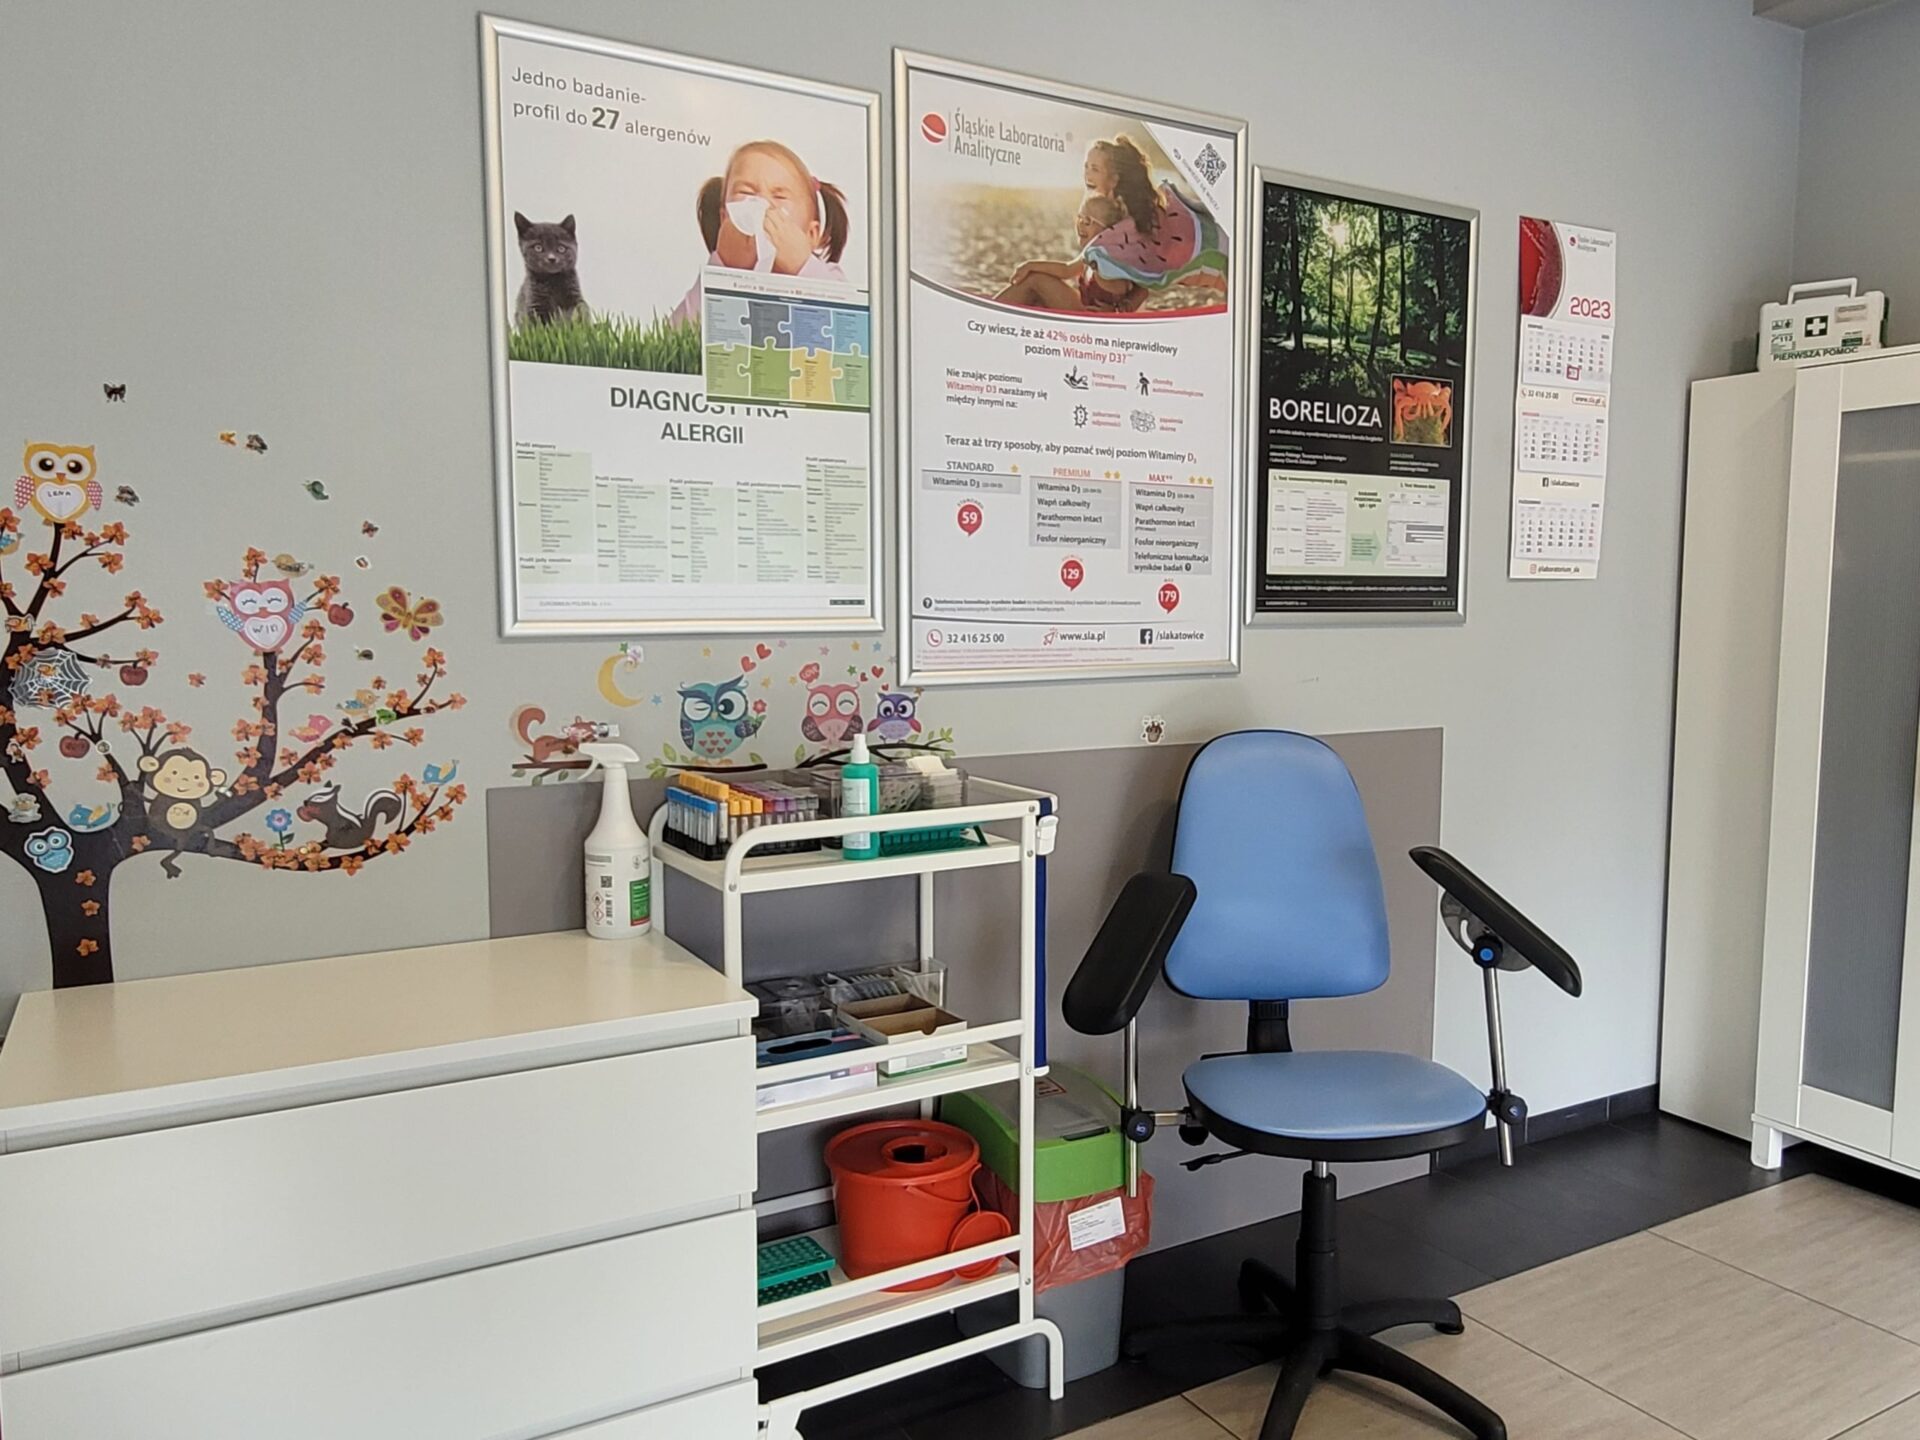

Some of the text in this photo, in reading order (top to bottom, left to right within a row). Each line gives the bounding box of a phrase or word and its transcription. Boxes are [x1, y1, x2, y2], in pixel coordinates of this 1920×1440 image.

[512, 67, 646, 103] Jedno badanie-
[513, 102, 711, 146] profil do 27 alergenów
[954, 107, 995, 139] Śląskie
[954, 135, 1021, 166] Analityczne
[1570, 296, 1612, 320] 2023
[967, 320, 1178, 357] Czy wiesz, że aż 42% osób ma nieprawidłowy
[1024, 344, 1060, 356] poziom
[1062, 347, 1107, 364] Witaminy
[1773, 347, 1859, 361] PIERWSZA POMOC
[946, 367, 1023, 384] Nie znając poziomu
[946, 381, 1048, 401] Witaminy D3 narażamy się
[946, 394, 976, 406] między
[977, 397, 1004, 408] innymi
[1268, 397, 1383, 428] BORELIOZA
[661, 422, 744, 444] ALERGII
[945, 434, 970, 446] Teraz
[972, 437, 982, 447] aż
[985, 438, 1002, 450] trzy
[1004, 440, 1043, 453] sposoby,
[1045, 442, 1061, 454] aby
[1063, 445, 1093, 455] poznać
[1095, 446, 1114, 458] swój
[1116, 448, 1147, 459] poziom
[1148, 450, 1186, 463] Witaminy
[946, 461, 994, 472] STANDARD
[1053, 468, 1090, 478] PREMIUM
[932, 477, 968, 487] Witamina
[1037, 483, 1070, 492] Witamina
[1135, 488, 1166, 497] Witamina
[1037, 498, 1090, 509] Wapń całkowity
[1135, 503, 1184, 514] Wapń całkowity
[961, 511, 978, 524] 59
[1037, 512, 1103, 523] Parathormon intact
[1135, 517, 1195, 527] Parathormon intact
[1036, 534, 1106, 546] Fosfor nieorganiczny
[1134, 537, 1199, 549] Fosfor nieorganiczny
[1134, 552, 1209, 563] Telefoniczna konsultacja
[1062, 568, 1080, 580] 129
[1134, 563, 1183, 573] wyników badań
[1160, 590, 1177, 603] 179
[946, 633, 1004, 644] 32 416 25 00
[1059, 631, 1106, 642] www.sla.pl
[1155, 630, 1205, 641] /slakatowice
